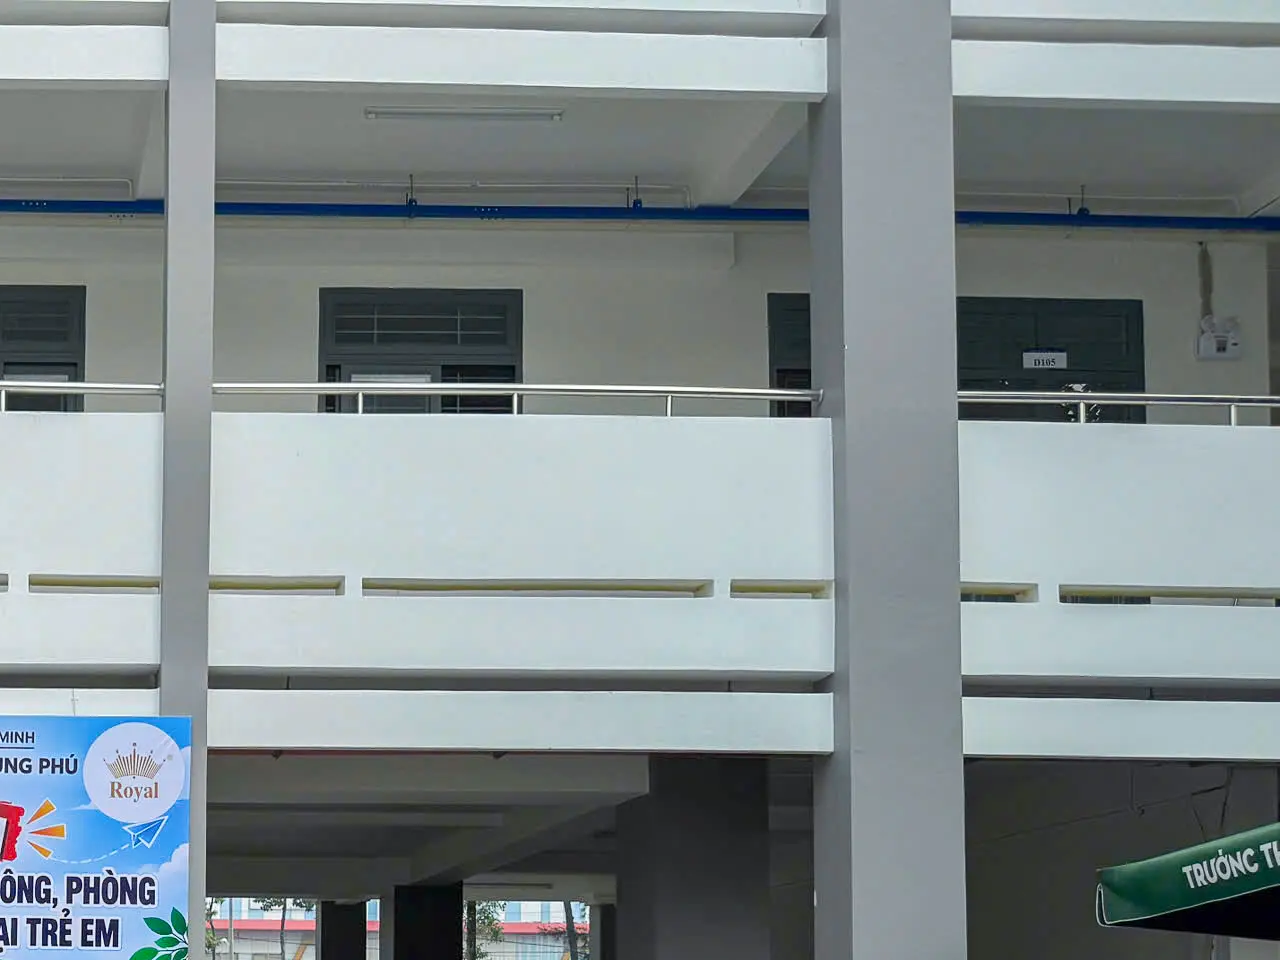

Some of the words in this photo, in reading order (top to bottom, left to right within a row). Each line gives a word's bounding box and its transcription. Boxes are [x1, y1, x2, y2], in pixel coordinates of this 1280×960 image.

[1034, 358, 1056, 366] D105
[38, 754, 78, 775] PHÚ
[109, 782, 158, 802] Royal
[66, 870, 156, 906] PHÒNG
[26, 908, 72, 947] TRẺ
[82, 918, 119, 948] EM
